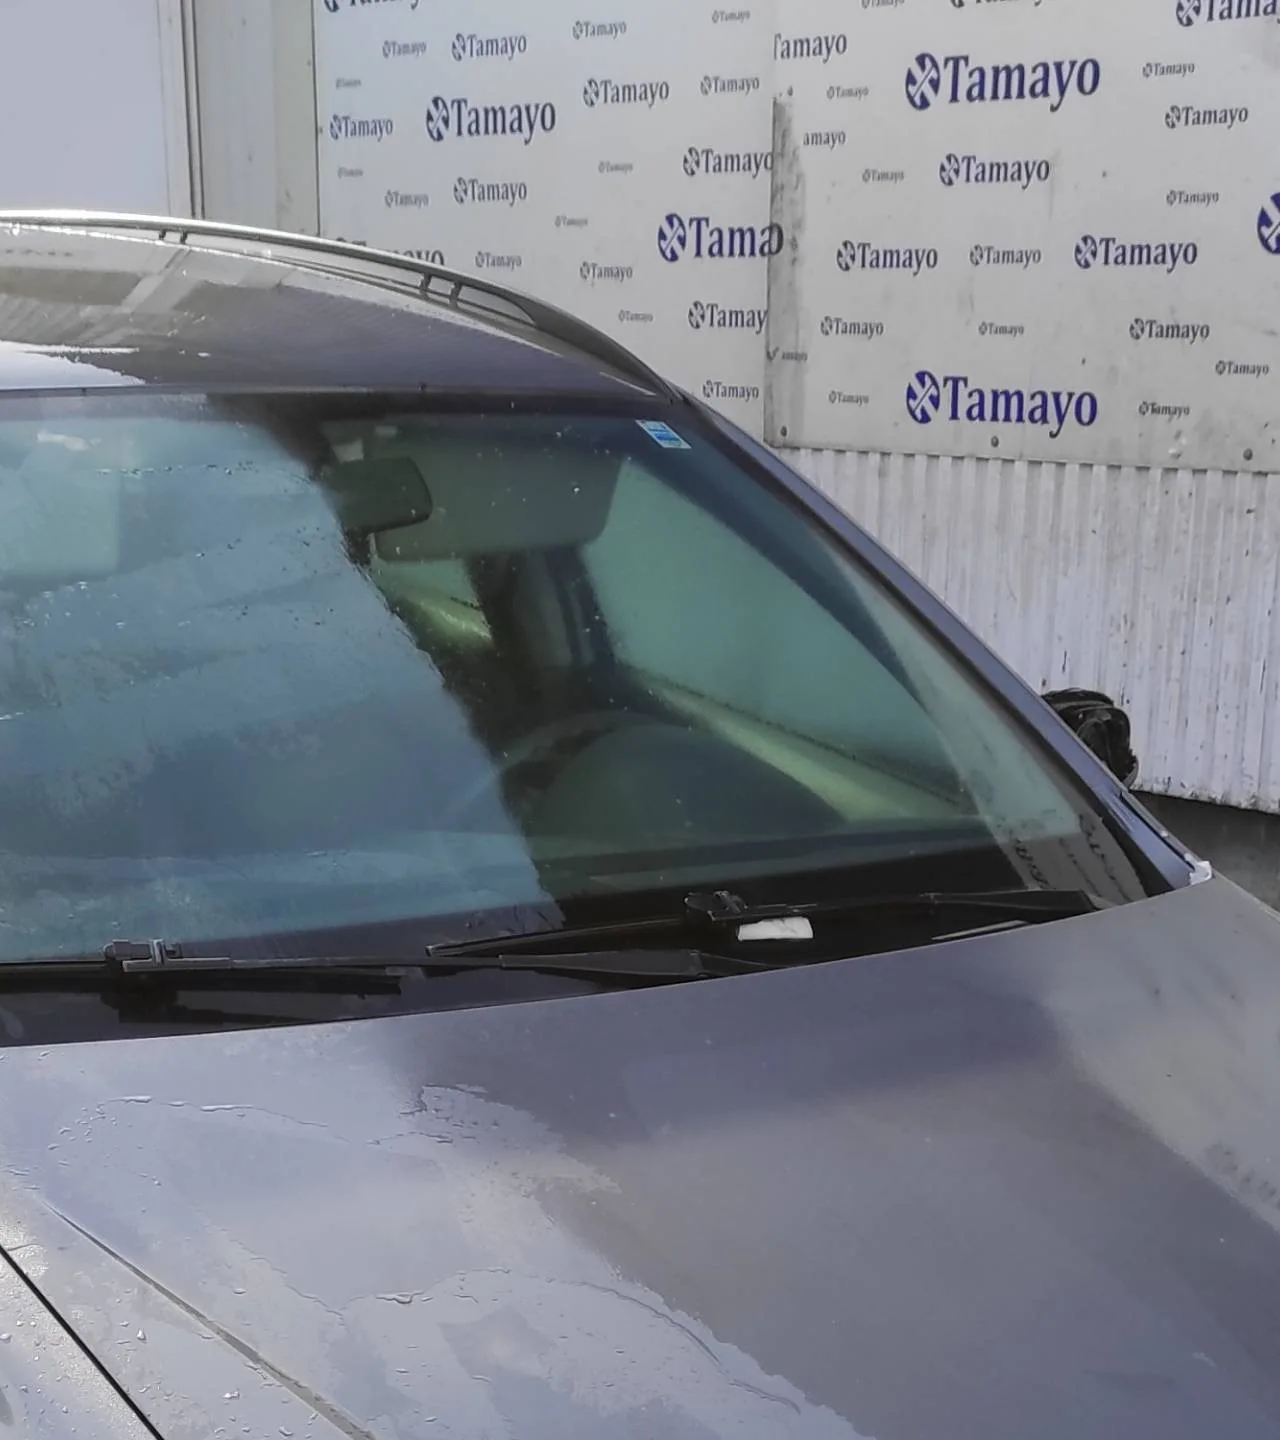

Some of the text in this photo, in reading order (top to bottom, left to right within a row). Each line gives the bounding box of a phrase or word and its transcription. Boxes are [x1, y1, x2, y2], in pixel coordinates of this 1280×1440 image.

[583, 21, 626, 39] Tamayo
[467, 34, 527, 60] Tamayo
[1153, 62, 1194, 77] Tamayo
[599, 79, 669, 108] Tamayo
[712, 77, 759, 97] Tamayo
[944, 55, 1100, 112] Tamayo
[342, 116, 393, 141] Tamayo
[451, 98, 556, 145] Tamayo
[1181, 106, 1248, 129] Tamayo
[803, 130, 846, 150] amayo
[962, 155, 1050, 190] Tamayo
[469, 179, 526, 206] Tamayo
[1177, 191, 1218, 206] Tamayo
[484, 252, 521, 270] Tamayo
[857, 242, 937, 276] Tamayo
[983, 245, 1041, 269] Tamayo
[1099, 237, 1197, 273] Tamayo
[592, 264, 632, 282] Tamayo
[706, 303, 768, 334] Tamay
[834, 318, 884, 340] Tamayo
[987, 322, 1024, 336] Tamayo
[1145, 320, 1210, 345] Tamayo
[1226, 361, 1269, 378] Tamayo
[714, 382, 759, 400] Tamayo
[943, 376, 1097, 438] Tamayo
